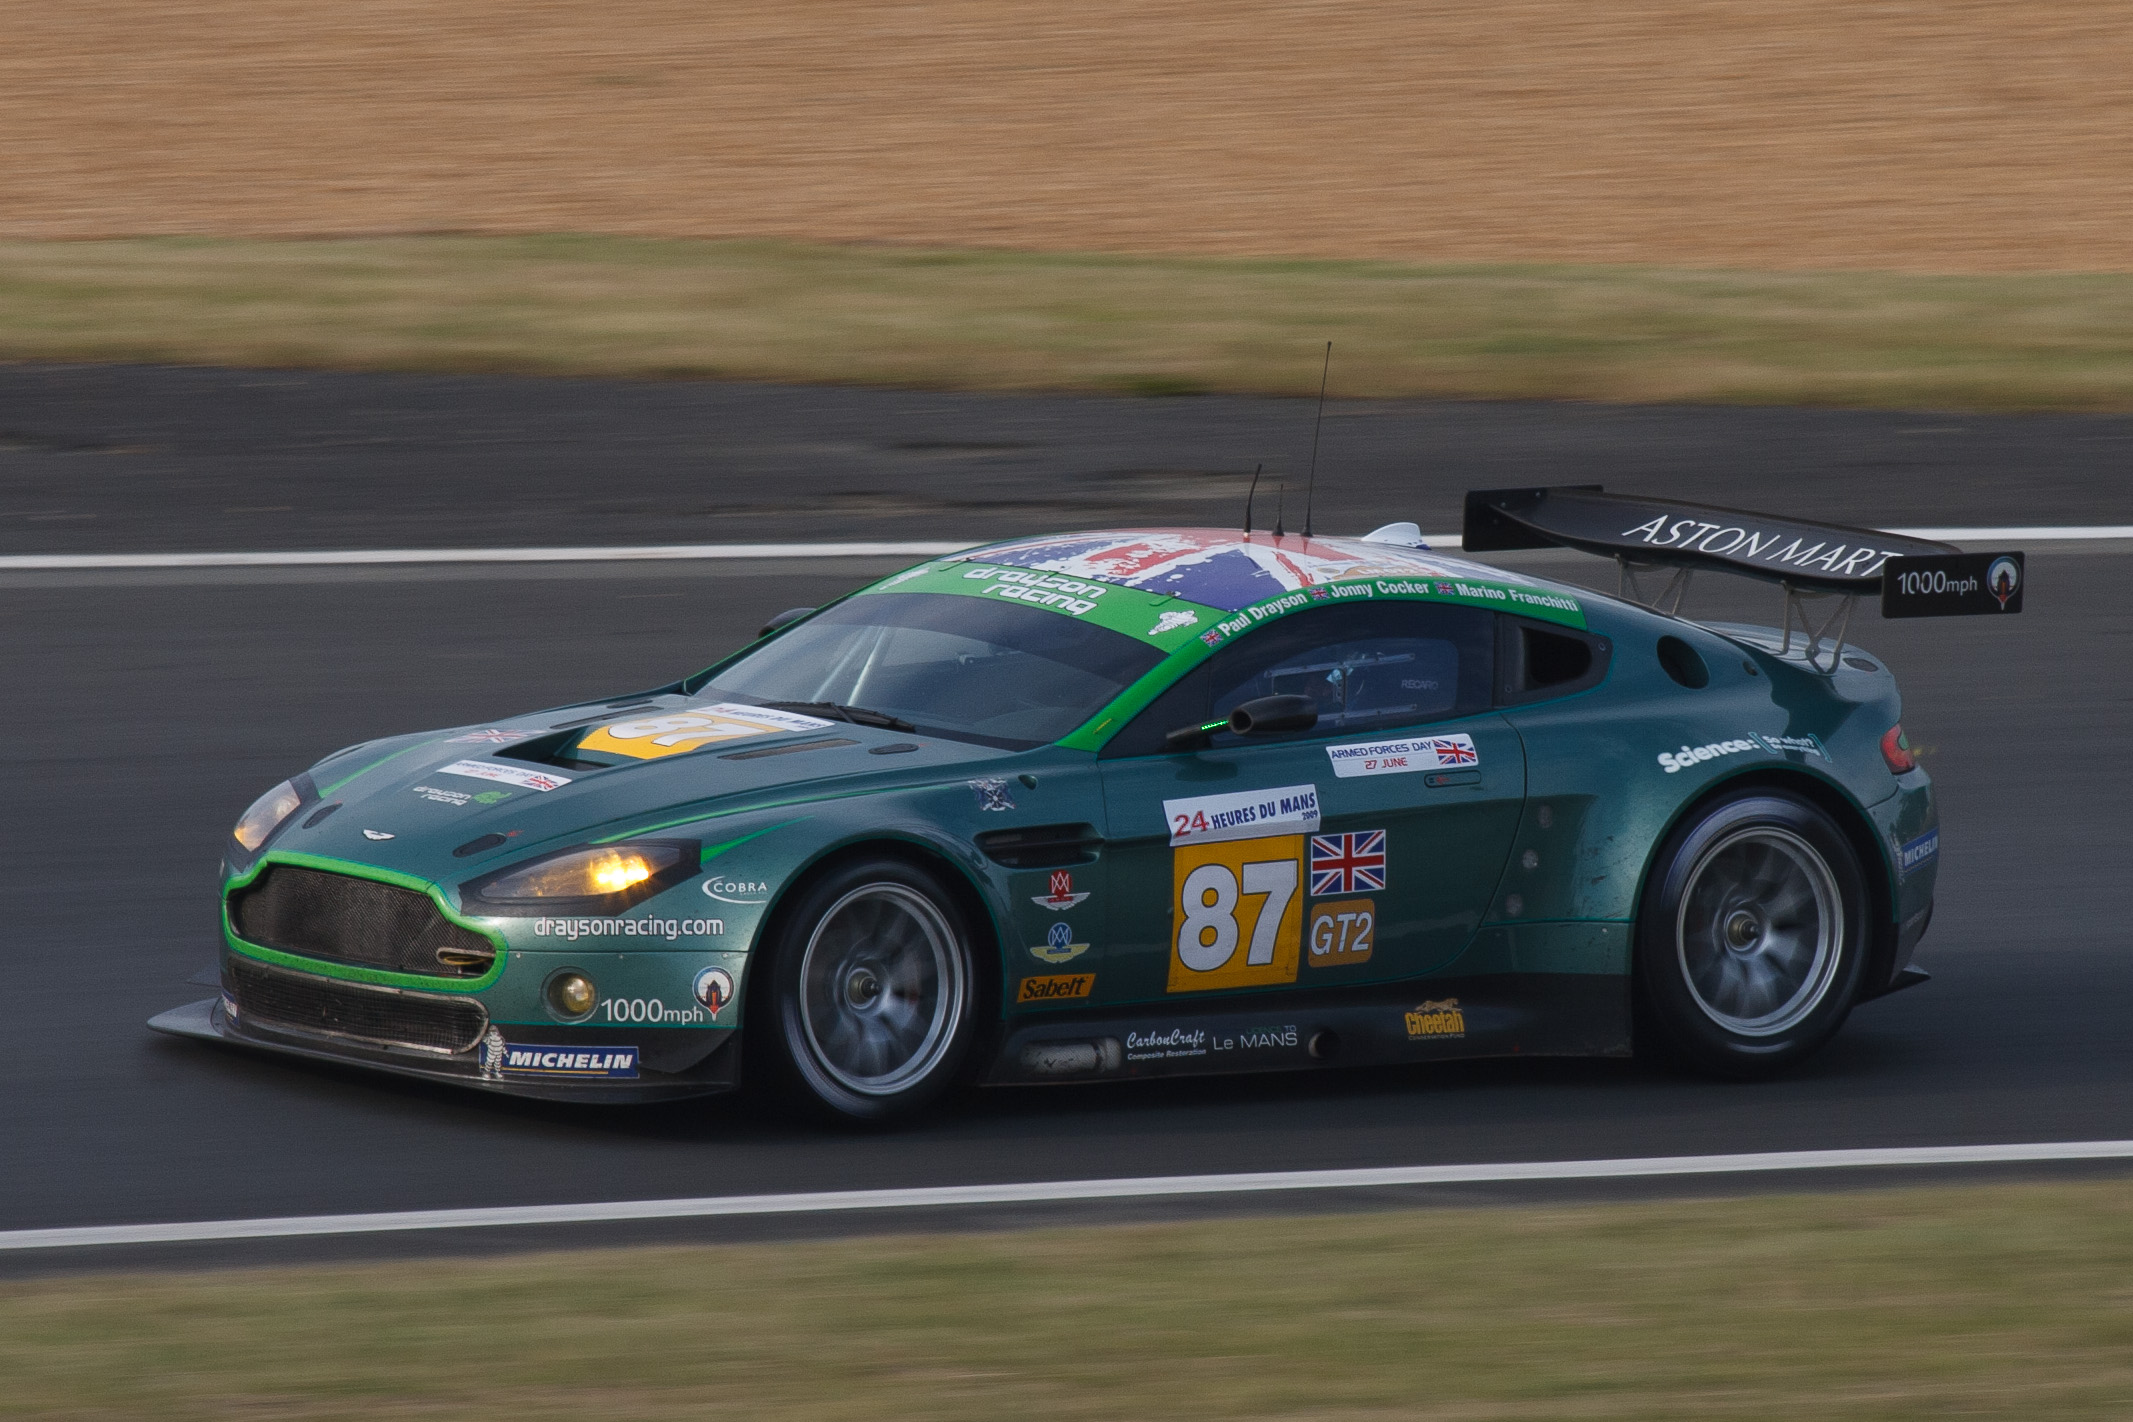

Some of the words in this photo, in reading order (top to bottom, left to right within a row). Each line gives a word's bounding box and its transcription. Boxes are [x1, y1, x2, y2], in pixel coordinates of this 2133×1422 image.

[1621, 514, 1780, 558] ASTON
[963, 566, 1108, 599] drayson
[1331, 584, 1373, 598] Jonny
[1376, 580, 1430, 595] Cocker
[1897, 571, 1978, 596] 1000mph
[982, 584, 1099, 616] racing
[1455, 583, 1506, 600] Marino
[1508, 589, 1579, 612] Franchitti
[1219, 612, 1252, 637] Paul
[1248, 593, 1308, 621] Drayson
[1401, 680, 1438, 690] RECARO
[608, 716, 768, 747] 87
[1331, 747, 1369, 759] ARMED
[1369, 744, 1409, 756] FORCES
[1413, 741, 1433, 752] DAY
[1364, 759, 1378, 770] 27
[1381, 757, 1408, 769] JUNE
[1174, 810, 1210, 837] 24
[1211, 806, 1256, 829] HEURES
[1259, 801, 1276, 819] DU
[1280, 792, 1316, 814] MANS
[1301, 810, 1318, 820] 2009
[713, 881, 768, 893] COBRA
[534, 915, 724, 940] draysonracing.com
[1177, 859, 1299, 972] 87
[1310, 912, 1373, 955] GT2
[1023, 978, 1087, 999] Sabelt
[600, 998, 704, 1025] 1000mph
[1405, 1010, 1464, 1035] Cheetah
[1213, 1036, 1234, 1050] Le
[1240, 1032, 1298, 1048] MANS
[509, 1051, 633, 1069] MICHELIN
[1127, 1052, 1164, 1061] Composite
